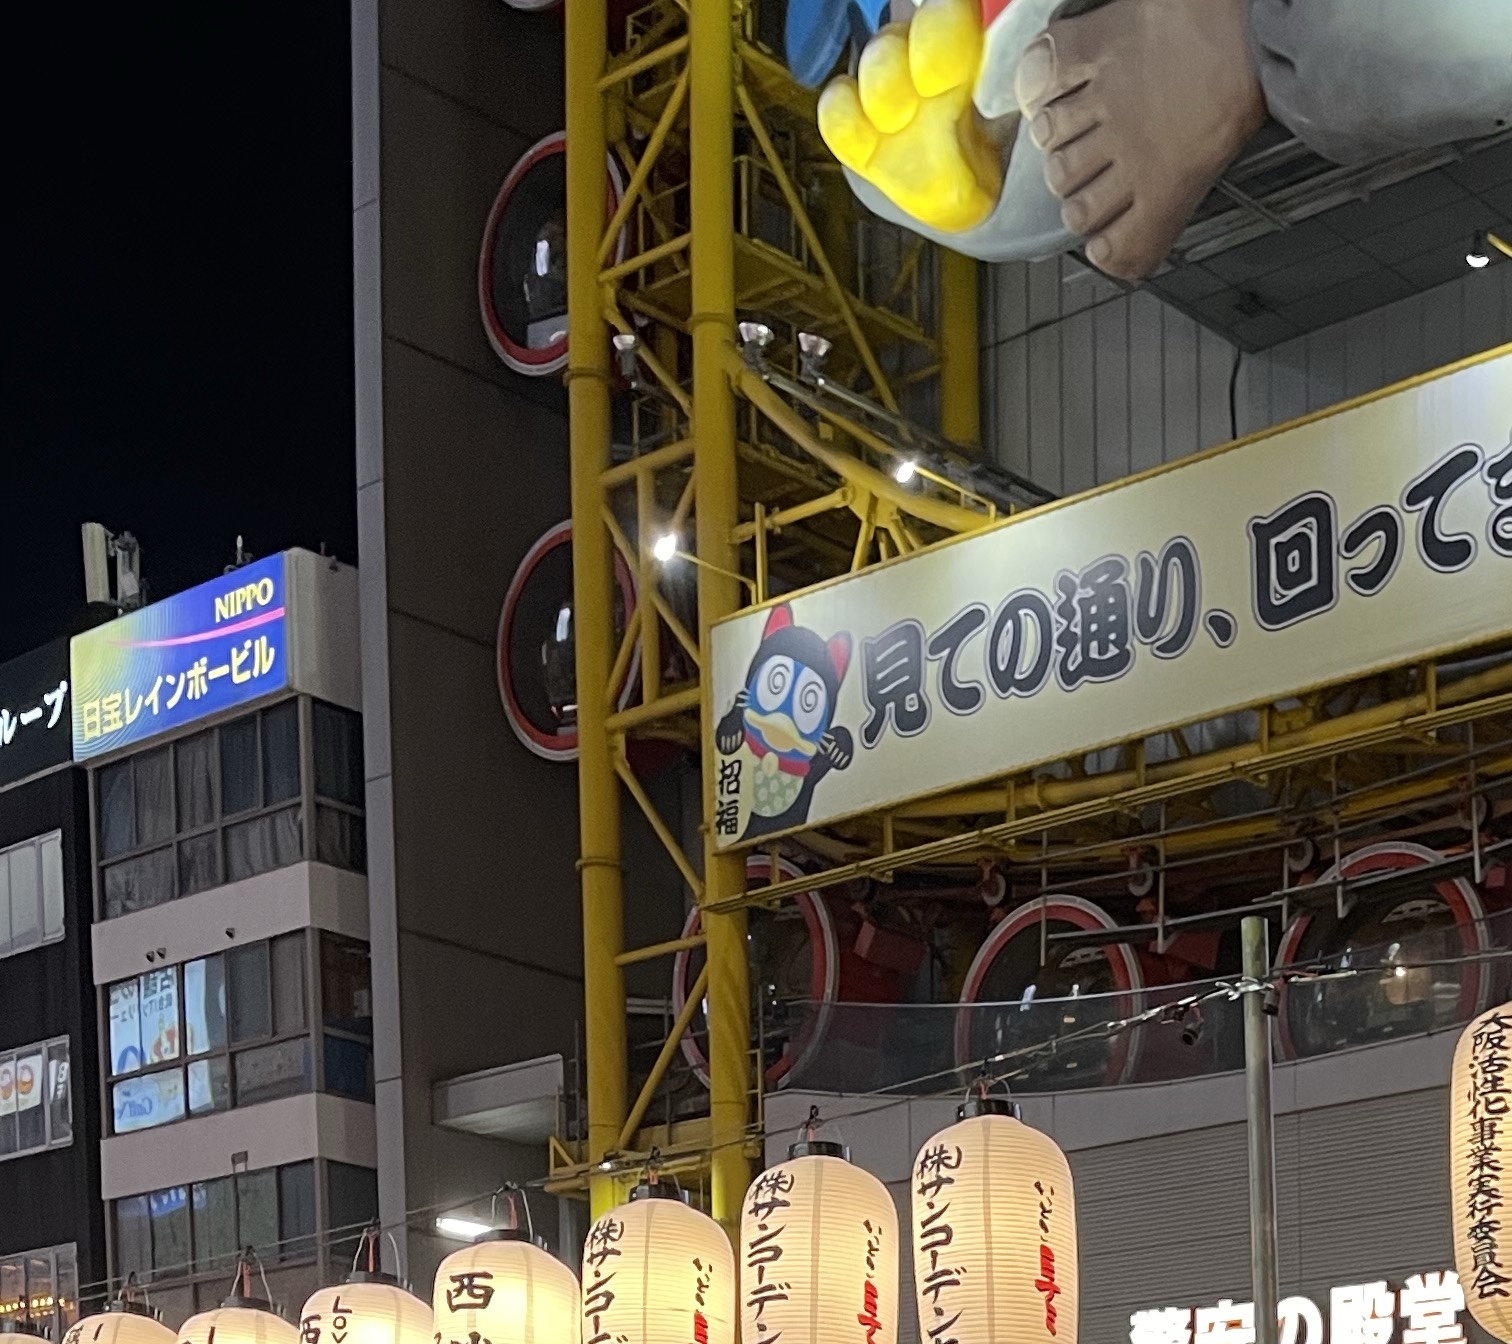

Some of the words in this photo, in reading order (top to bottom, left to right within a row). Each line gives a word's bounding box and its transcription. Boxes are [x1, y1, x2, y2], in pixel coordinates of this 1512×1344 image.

[215, 578, 274, 622] NIPPO
[83, 636, 275, 741] 日宝レインボービル
